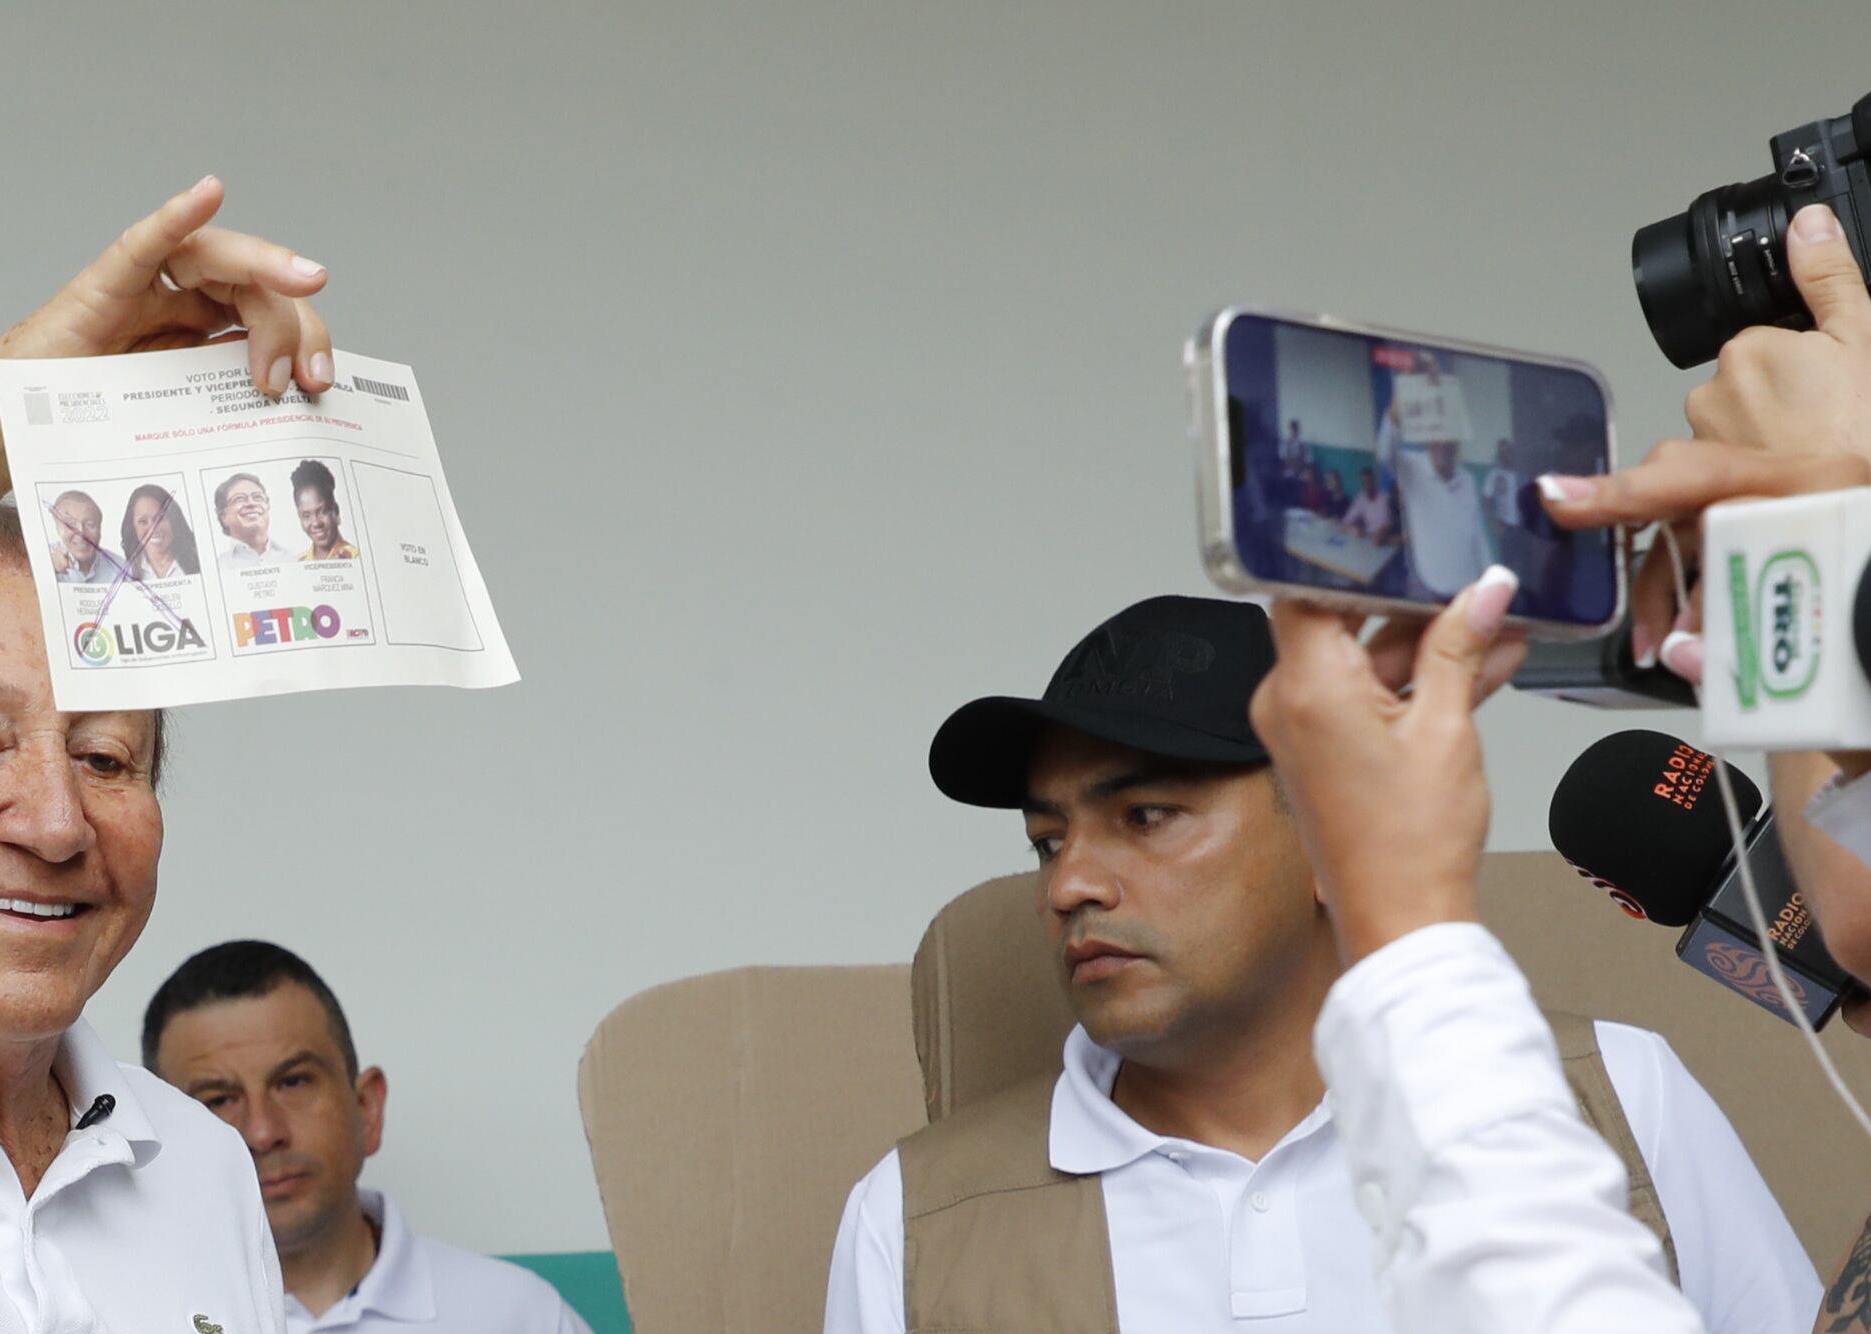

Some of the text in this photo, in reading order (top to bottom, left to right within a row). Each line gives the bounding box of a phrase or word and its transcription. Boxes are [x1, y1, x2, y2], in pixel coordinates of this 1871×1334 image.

[123, 388, 192, 402] PRESIDENTE
[217, 401, 271, 415] SEGUNDA
[61, 406, 110, 423] 2022
[114, 618, 207, 655] LIGA
[232, 604, 341, 648] PETRO
[1654, 744, 1694, 798] RADIO
